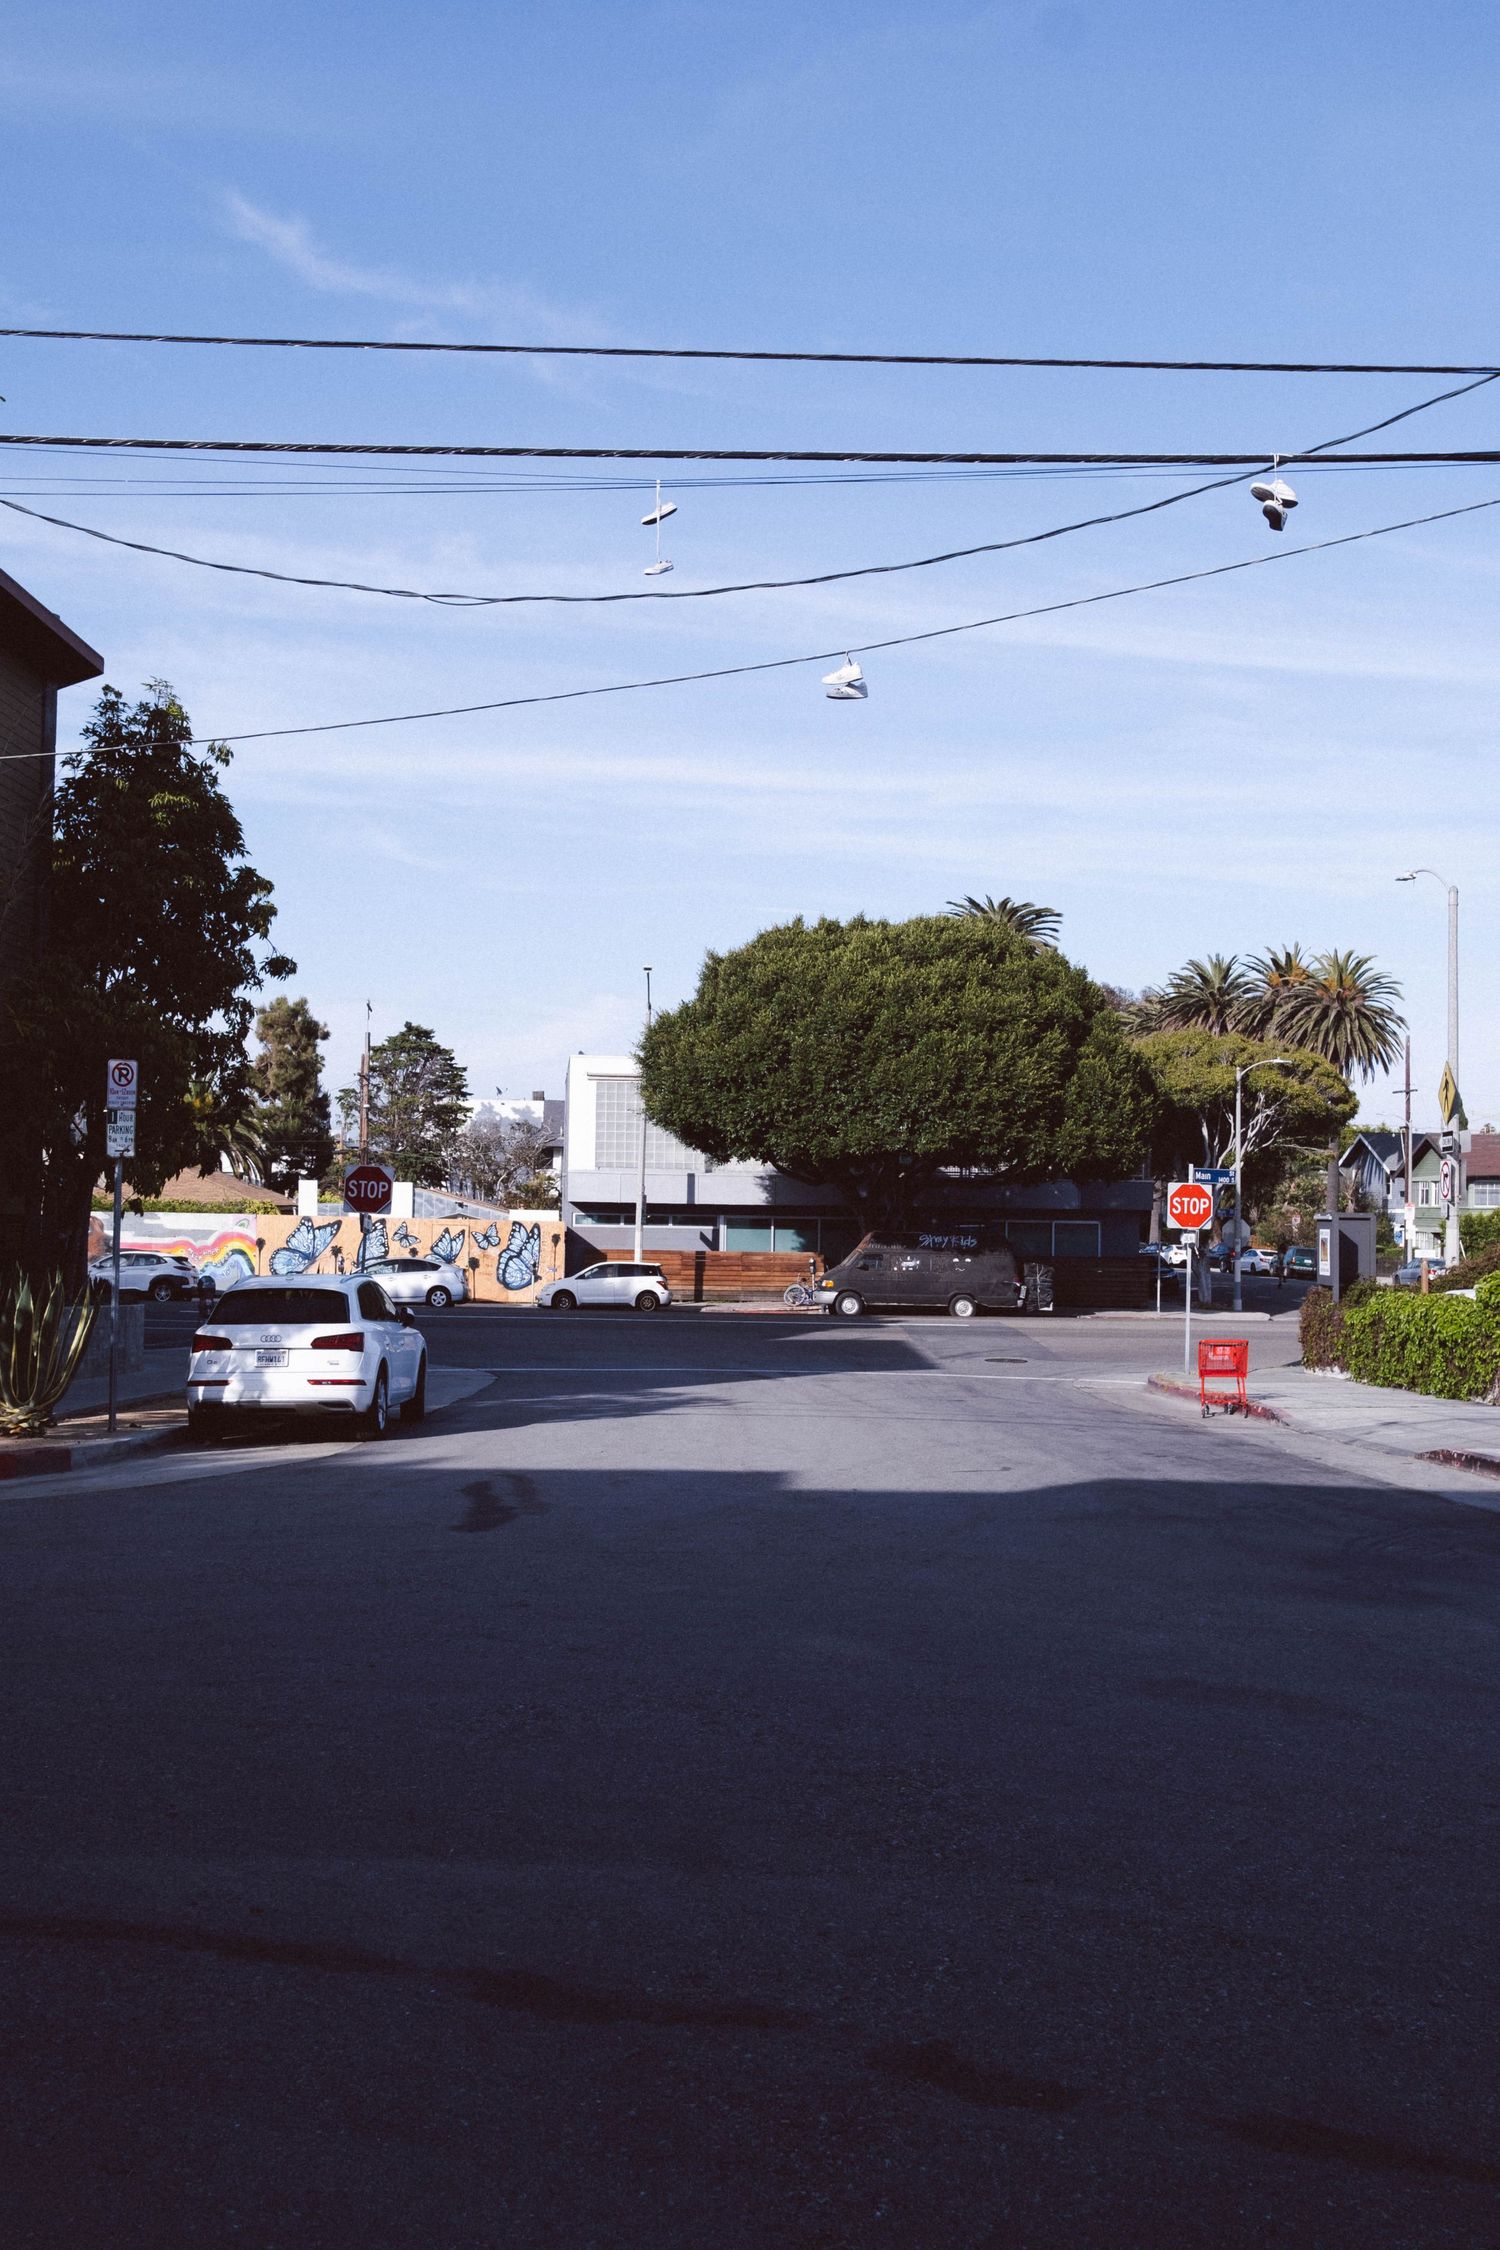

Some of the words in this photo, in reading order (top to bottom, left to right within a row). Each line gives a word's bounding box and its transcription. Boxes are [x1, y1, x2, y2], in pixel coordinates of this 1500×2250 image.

[118, 1112, 134, 1122] HOUR
[108, 1125, 134, 1134] PARKING
[1195, 1171, 1211, 1180] Main
[347, 1180, 389, 1199] STOP
[1172, 1197, 1209, 1214] STOP
